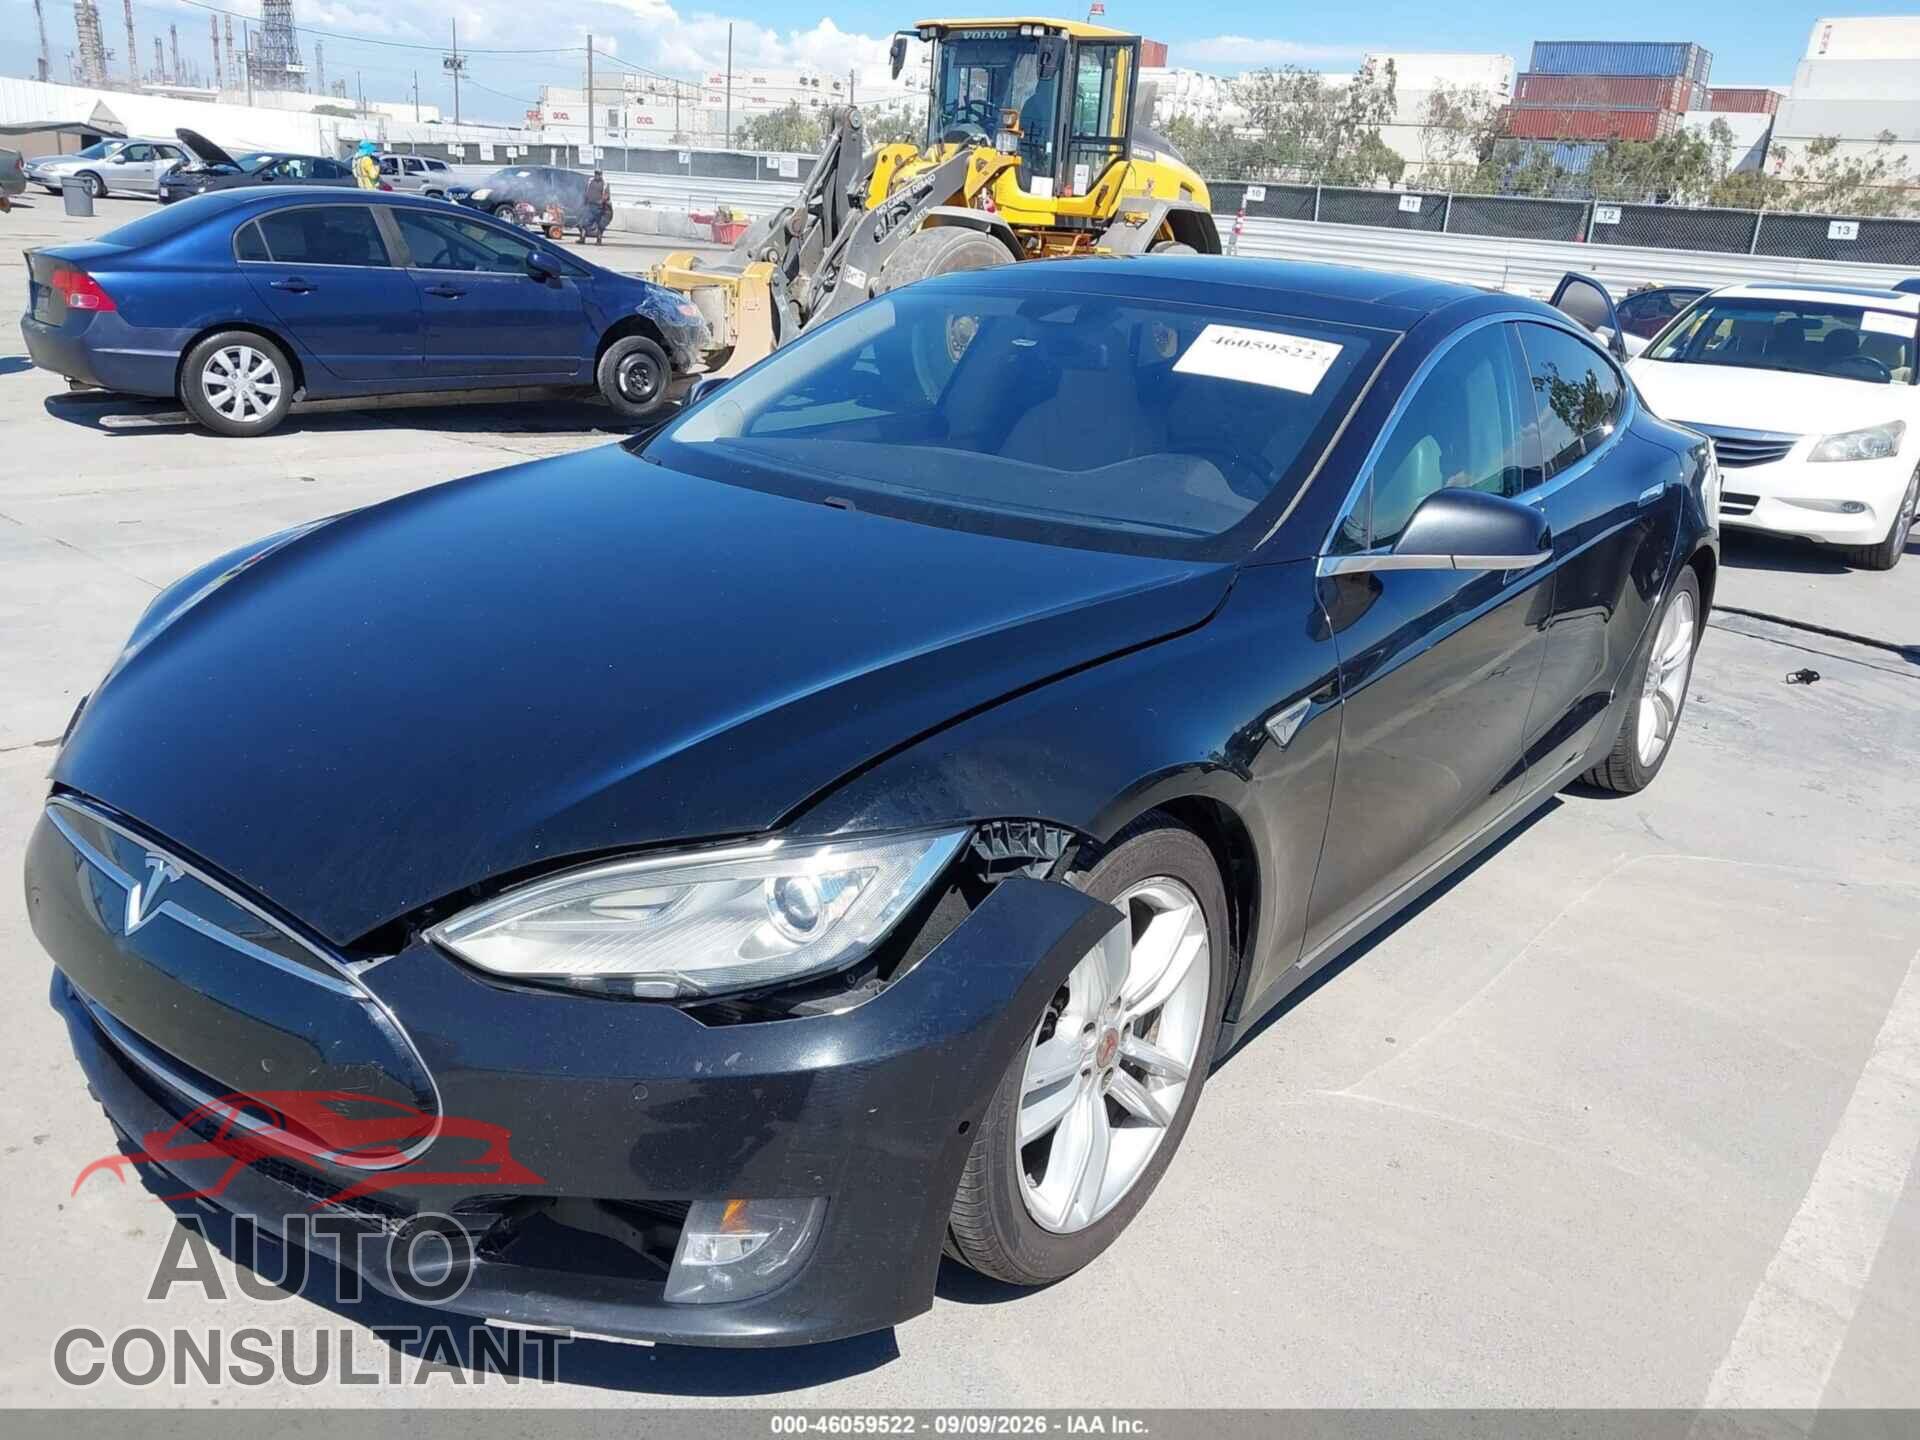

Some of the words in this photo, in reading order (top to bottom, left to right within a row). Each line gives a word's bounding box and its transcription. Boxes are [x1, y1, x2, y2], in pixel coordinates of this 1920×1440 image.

[963, 30, 1008, 40] VOLVO
[1251, 188, 1262, 198] 10
[1405, 200, 1416, 210] 11
[1601, 209, 1616, 221] 12
[1836, 225, 1851, 237] 13
[1210, 335, 1317, 360] 46059522
